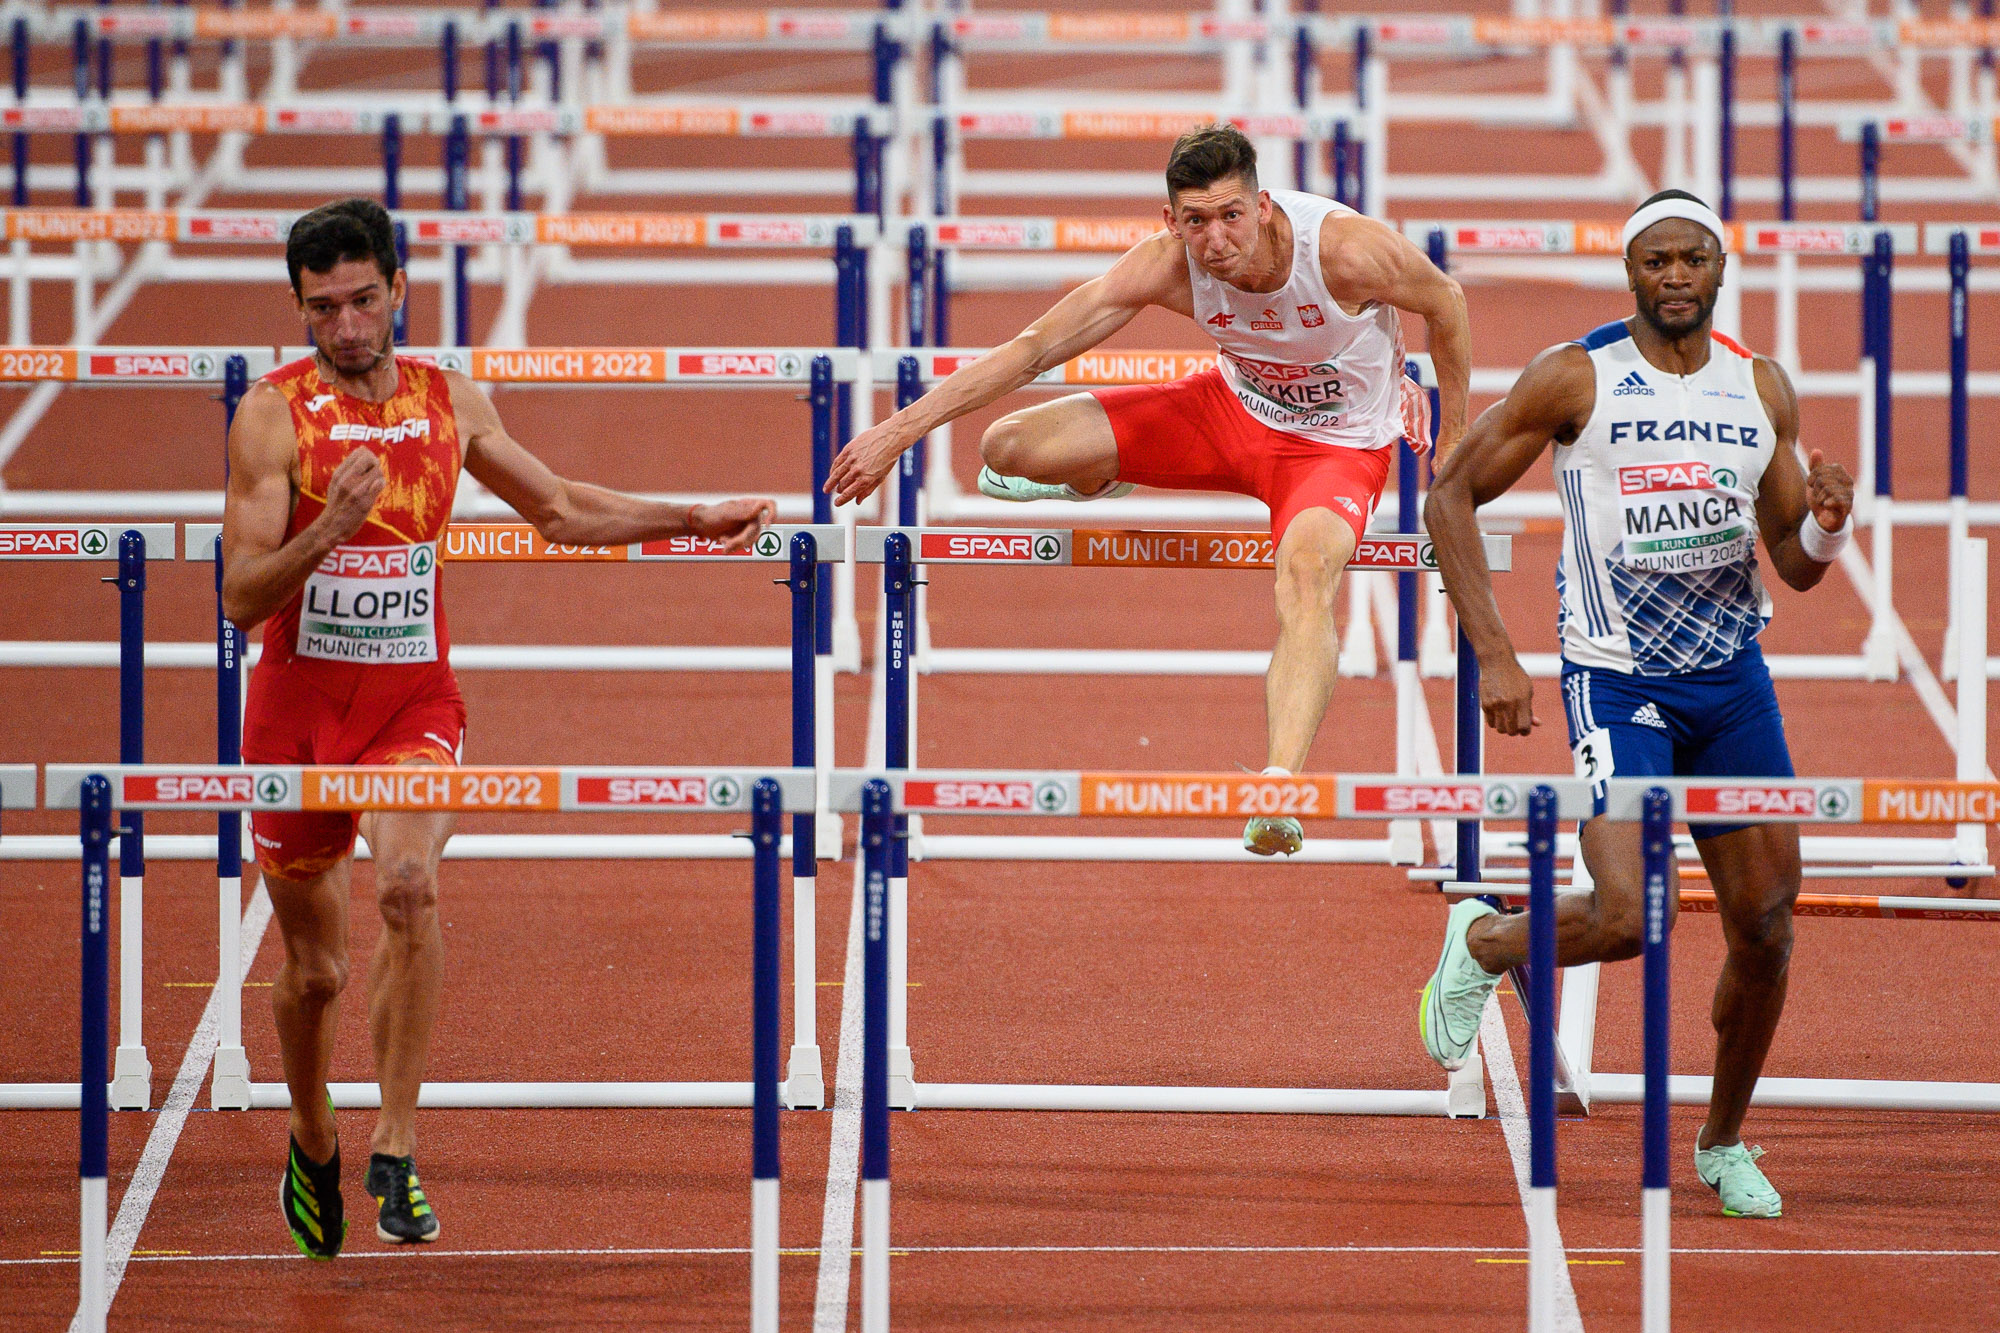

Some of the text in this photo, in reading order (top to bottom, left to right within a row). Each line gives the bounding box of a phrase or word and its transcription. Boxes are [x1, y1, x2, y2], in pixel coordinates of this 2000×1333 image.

[1252, 322, 1282, 330] ORLEN
[2, 354, 64, 377] 2022
[115, 357, 187, 374] SPAR
[484, 354, 652, 377] MUNICH 2022
[703, 356, 774, 374] SPAR
[1078, 356, 1176, 380] MUNICH
[1613, 385, 1655, 396] adidas
[329, 417, 430, 443] ESPAÑA
[1301, 413, 1339, 428] 2022
[1610, 420, 1759, 449] FRANCE
[1622, 465, 1714, 491] SPAR
[1625, 497, 1742, 535] MANGA
[0, 533, 77, 551] SPAR
[447, 531, 532, 555] UNICH
[670, 536, 751, 552] SPA
[949, 537, 1030, 557] SPAR
[1088, 537, 1275, 563] MUNICH 2022
[1355, 544, 1416, 563] PAR
[1662, 538, 1687, 551] RUN
[319, 551, 406, 575] SPAR
[1634, 540, 1744, 571] MUNICH 2022
[308, 585, 429, 619] LLOPIS
[223, 619, 235, 669] MONDO
[307, 636, 428, 658] MUNICH 2022
[892, 620, 904, 669] MONDO
[1581, 744, 1598, 778] 3
[155, 777, 252, 800] SPAR
[319, 775, 541, 804] MUNICH 2022
[608, 779, 704, 802] SPAR
[934, 782, 1032, 806] SPAR
[1096, 783, 1320, 814] MUNICH 2022
[1383, 787, 1481, 810] SPAR
[1716, 790, 1814, 812] SPAR
